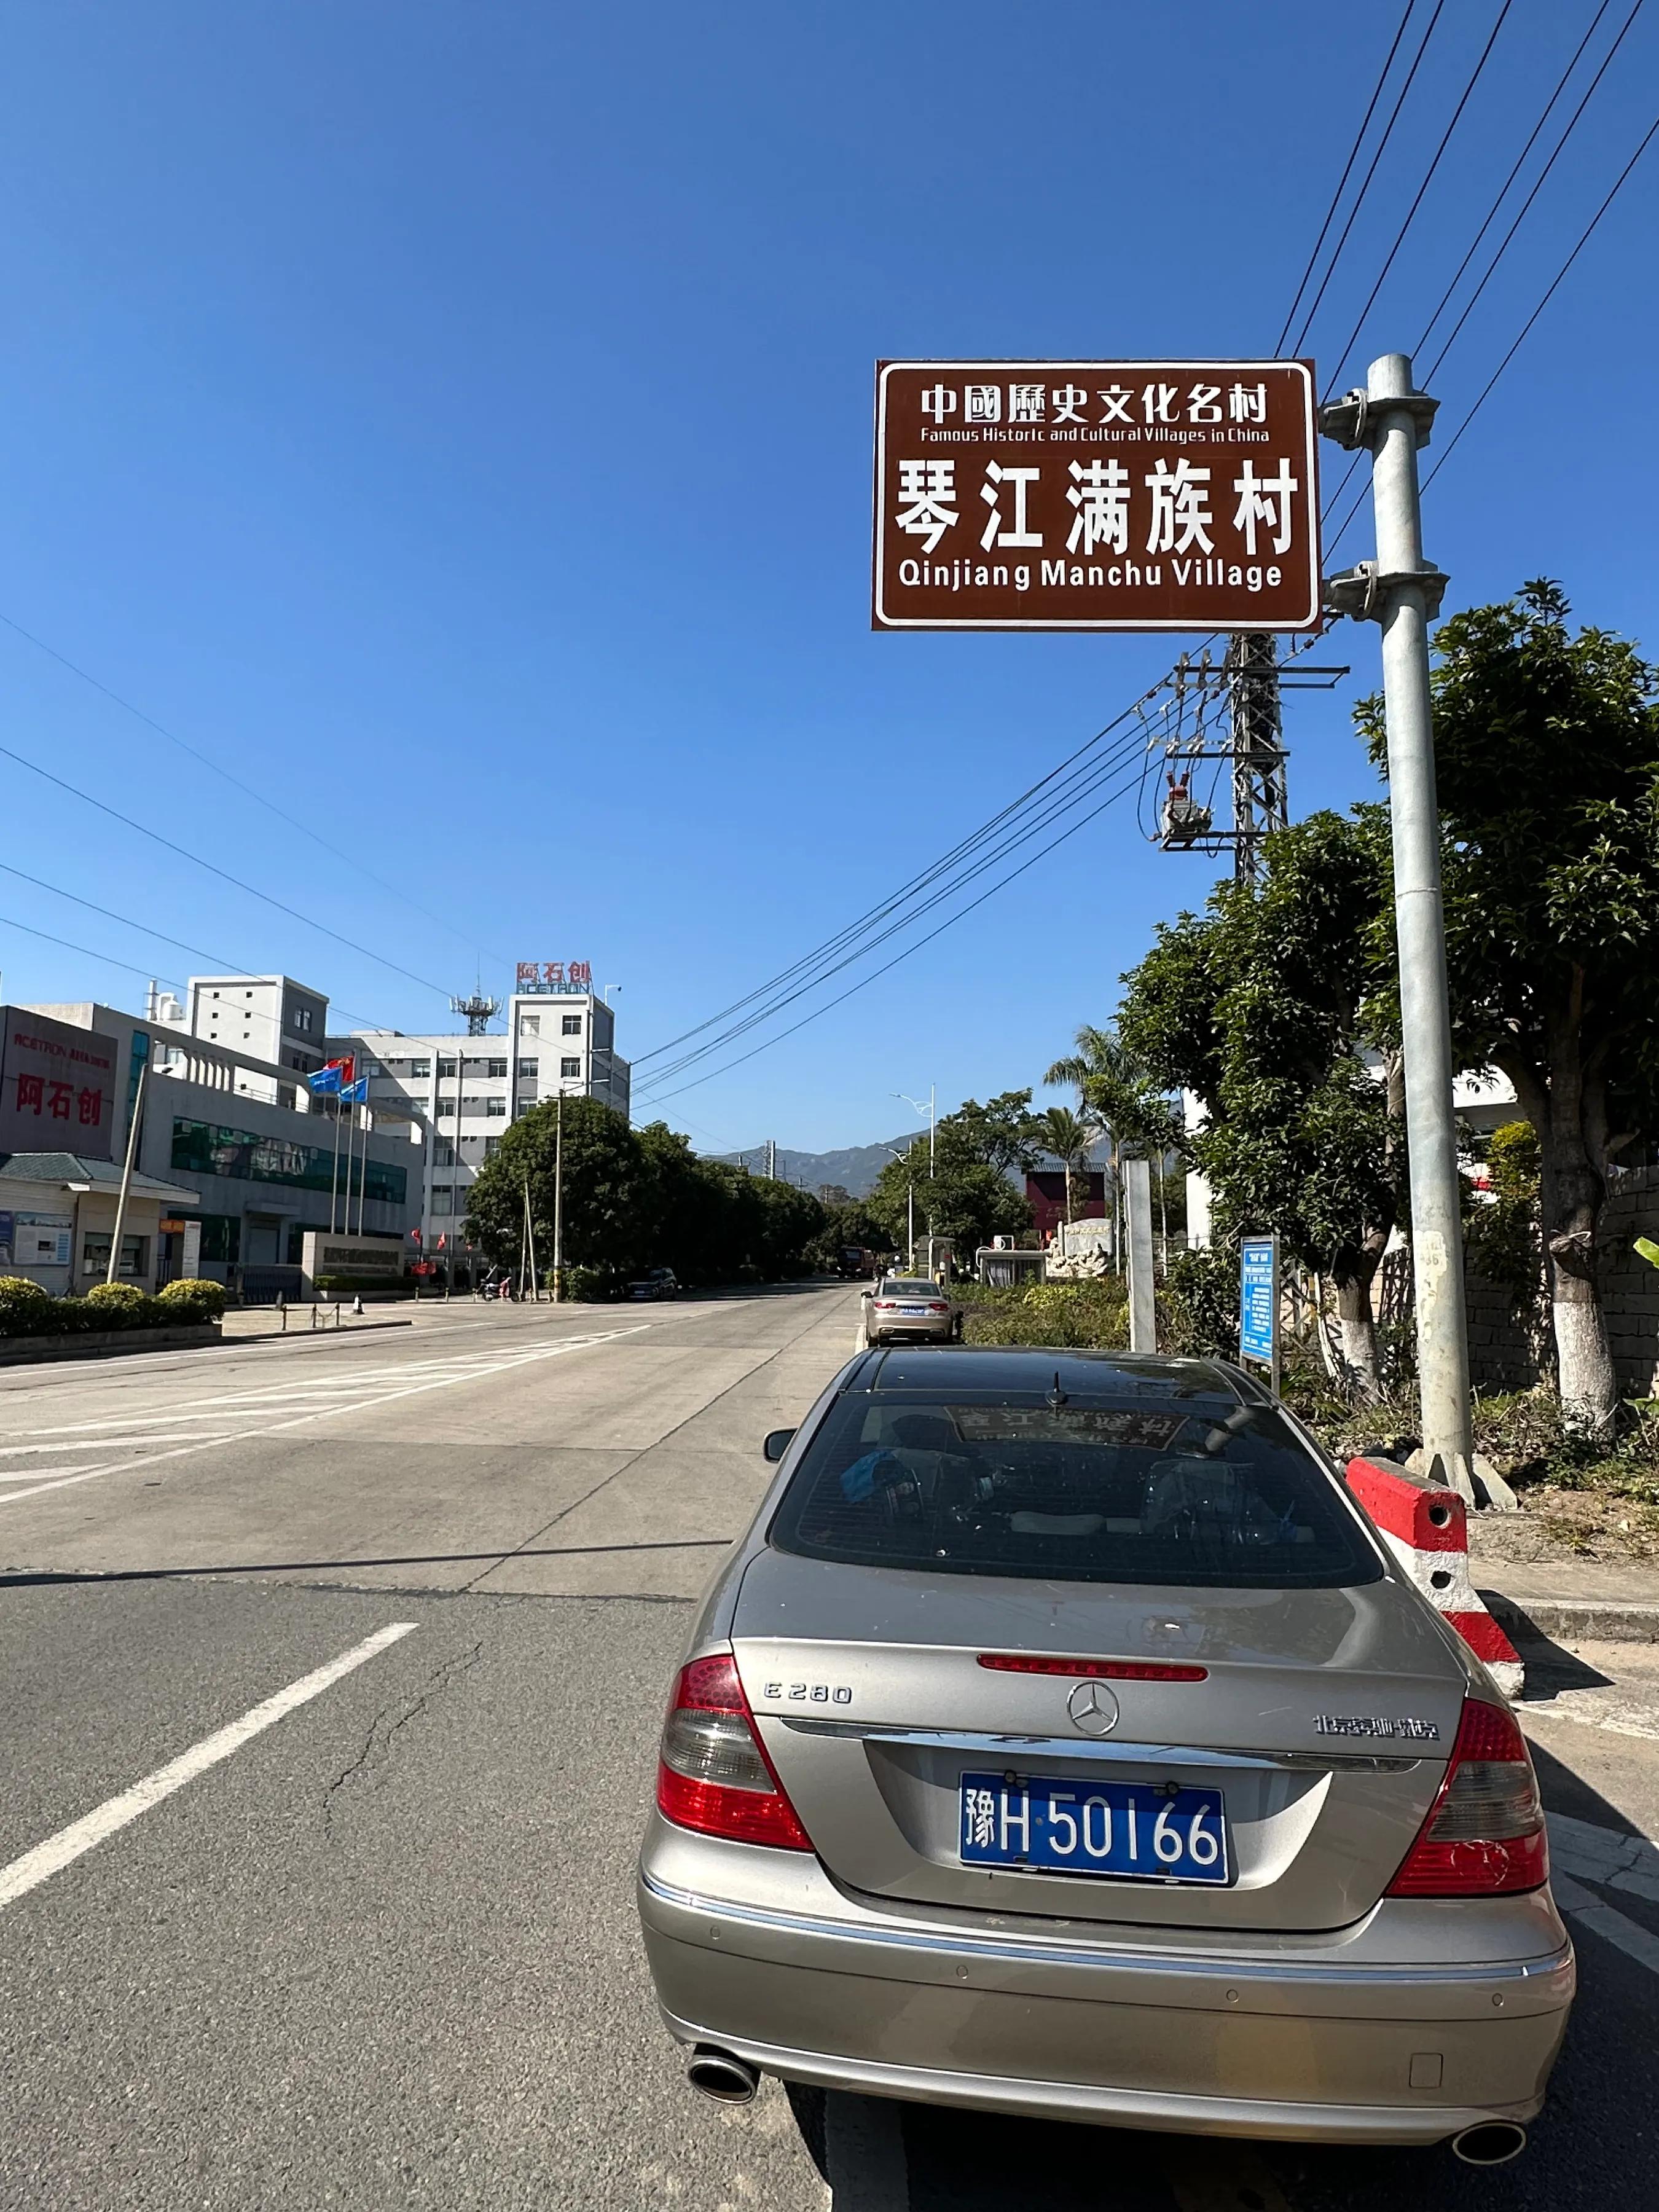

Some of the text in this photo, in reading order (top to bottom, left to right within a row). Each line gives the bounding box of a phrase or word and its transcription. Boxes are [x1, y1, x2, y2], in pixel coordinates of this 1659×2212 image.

[921, 383, 1268, 424] 中國歷史文化名村
[921, 426, 1269, 445] Famous Historic and Cultural Villages in China
[895, 457, 1298, 555] 琴江满族村
[899, 559, 1282, 592] Qinjiang Manchu Village
[517, 960, 590, 984] 阿石创
[17, 1073, 102, 1126] 阿石创
